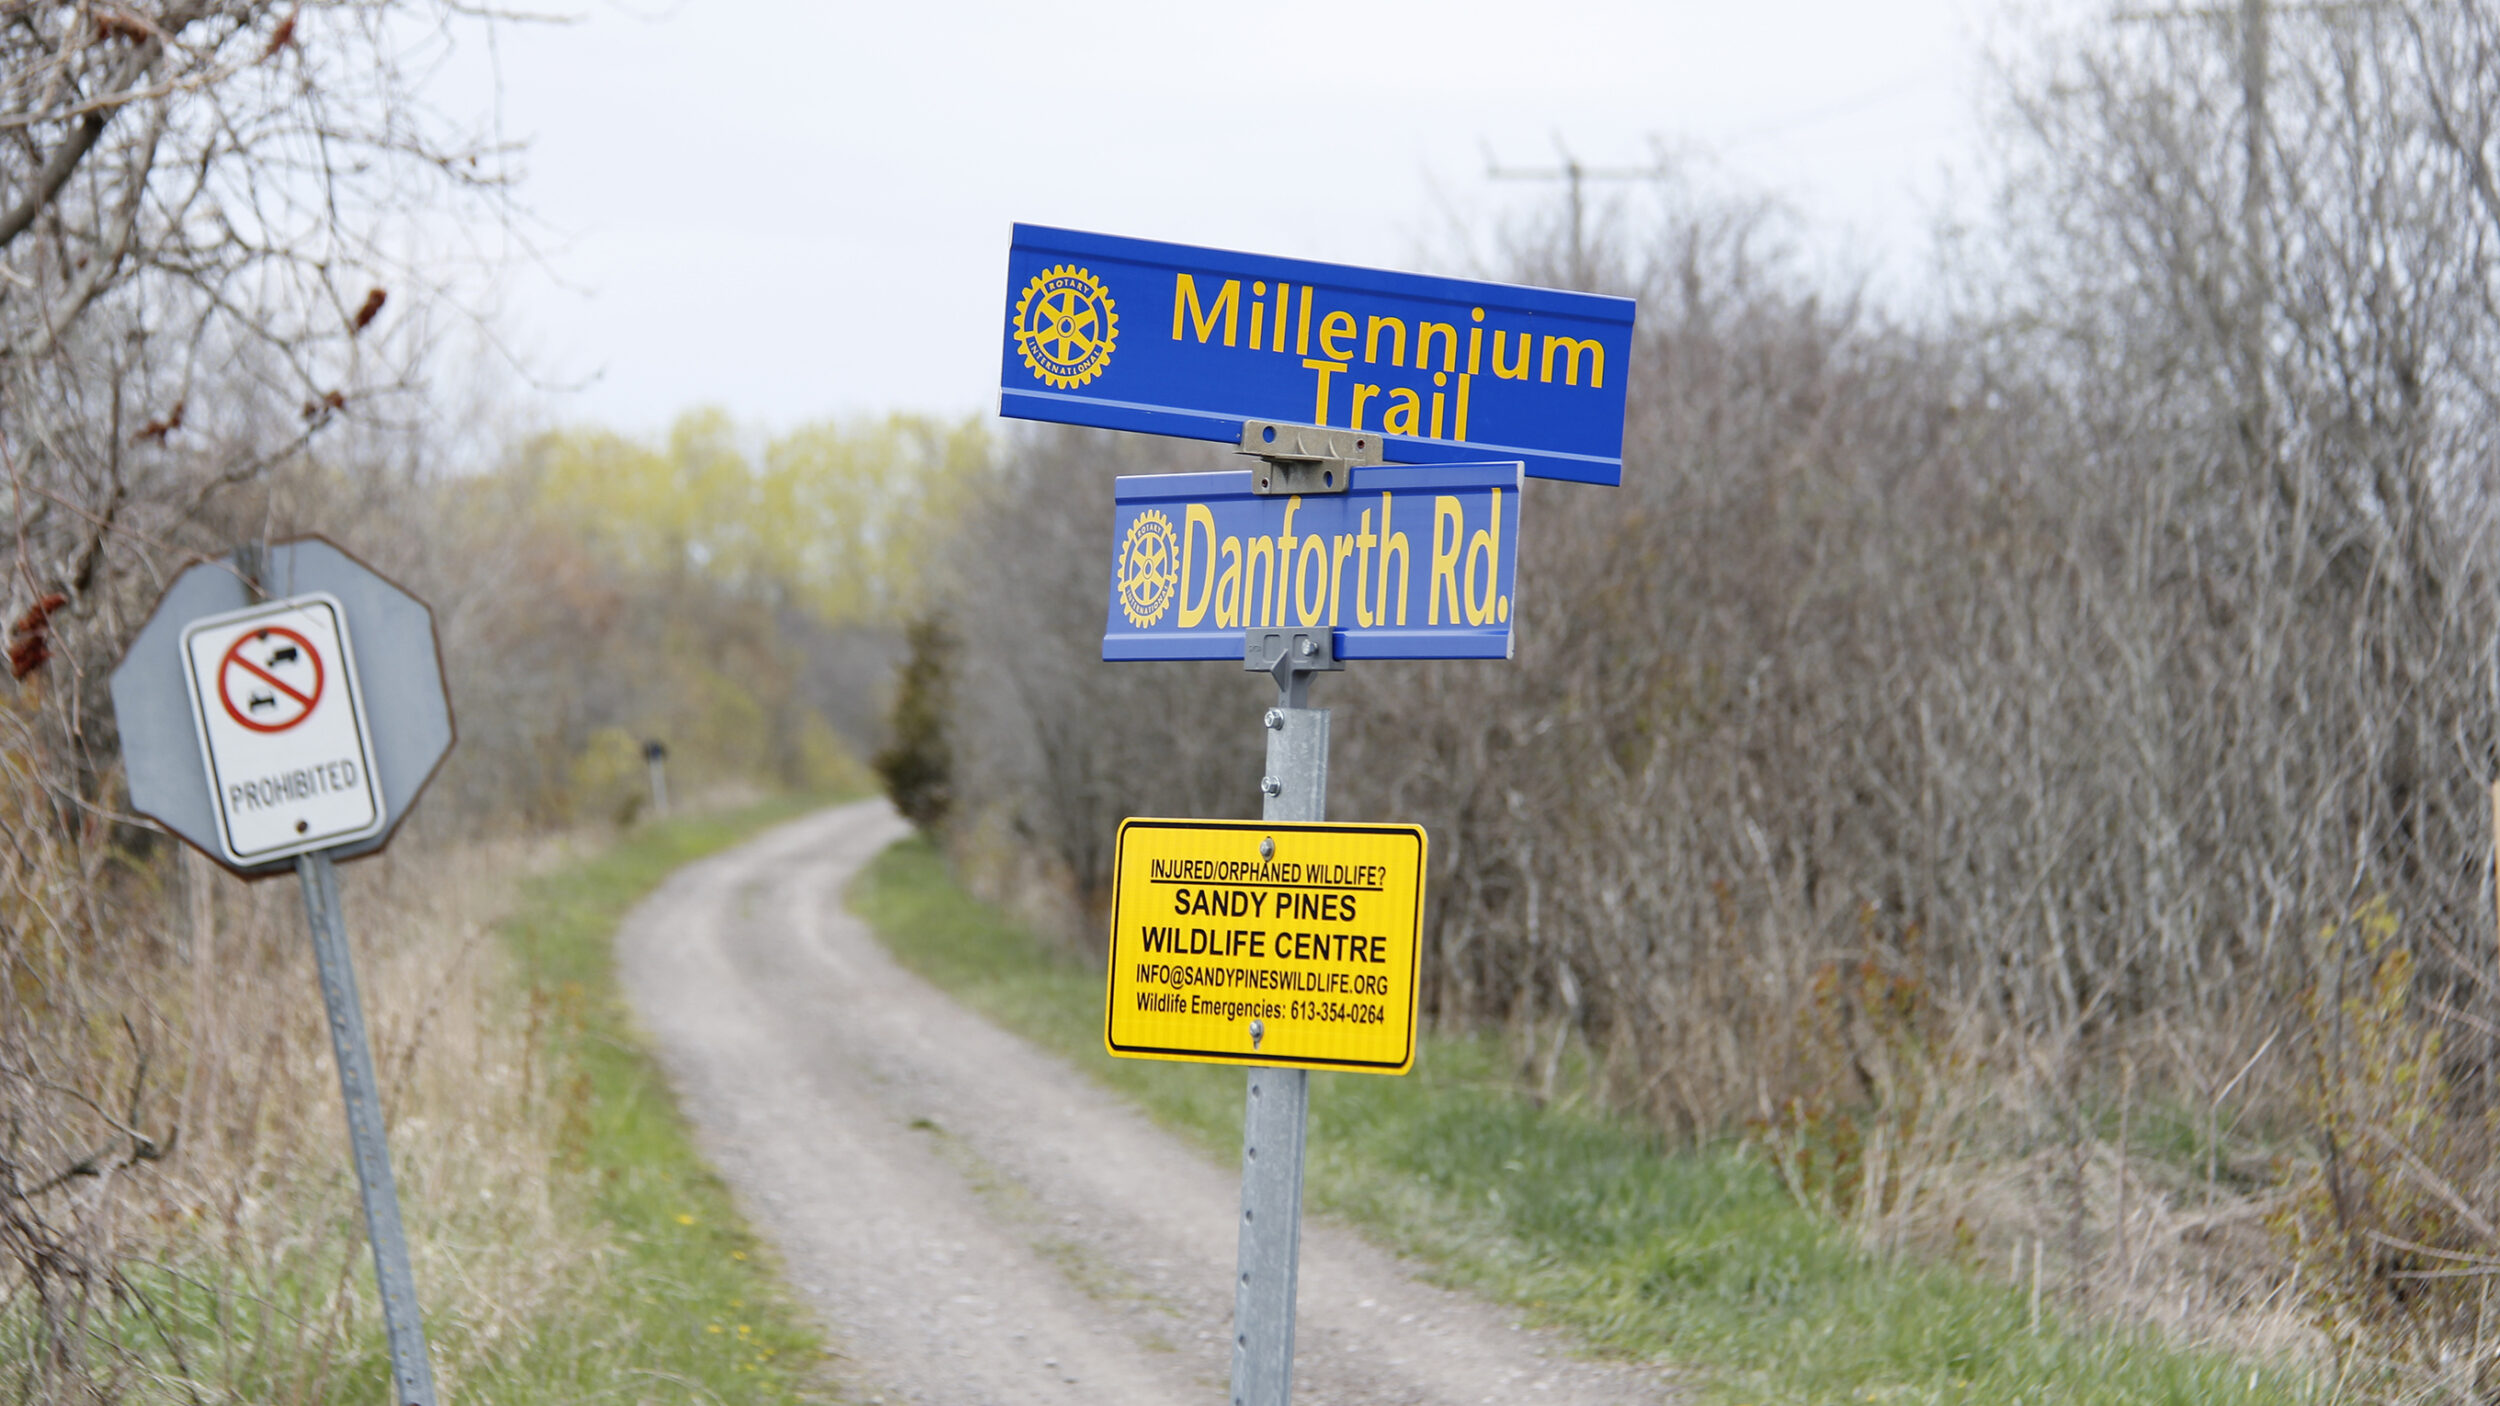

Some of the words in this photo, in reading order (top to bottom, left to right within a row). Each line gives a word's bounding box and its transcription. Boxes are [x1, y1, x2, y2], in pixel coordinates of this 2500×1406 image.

[1048, 278, 1090, 294] ROTARY
[1171, 272, 1605, 389] Millennium
[1028, 341, 1101, 376] INTERNATIONAL
[1302, 357, 1471, 442] Trail
[1137, 523, 1162, 538] ROTARY
[1177, 491, 1410, 629] Danforth
[1428, 487, 1509, 627] Rd.
[1126, 586, 1169, 615] INTERNATIONAL
[228, 759, 358, 815] PROHIBITED
[1150, 858, 1302, 883] INJURED/ORPHANED
[1306, 863, 1387, 886] WILDLIFE?
[1174, 888, 1268, 918] SANDY
[1275, 892, 1357, 922] PINES
[1142, 926, 1266, 958] WILDLIFE
[1274, 931, 1387, 963] CENTRE
[1136, 963, 1388, 995] INFO@SANDYPINESWILDLIFE.ORG
[1136, 991, 1187, 1014] Wildlife
[1191, 995, 1286, 1021] Emergencies:
[1290, 1000, 1385, 1024] 613-354-0264
